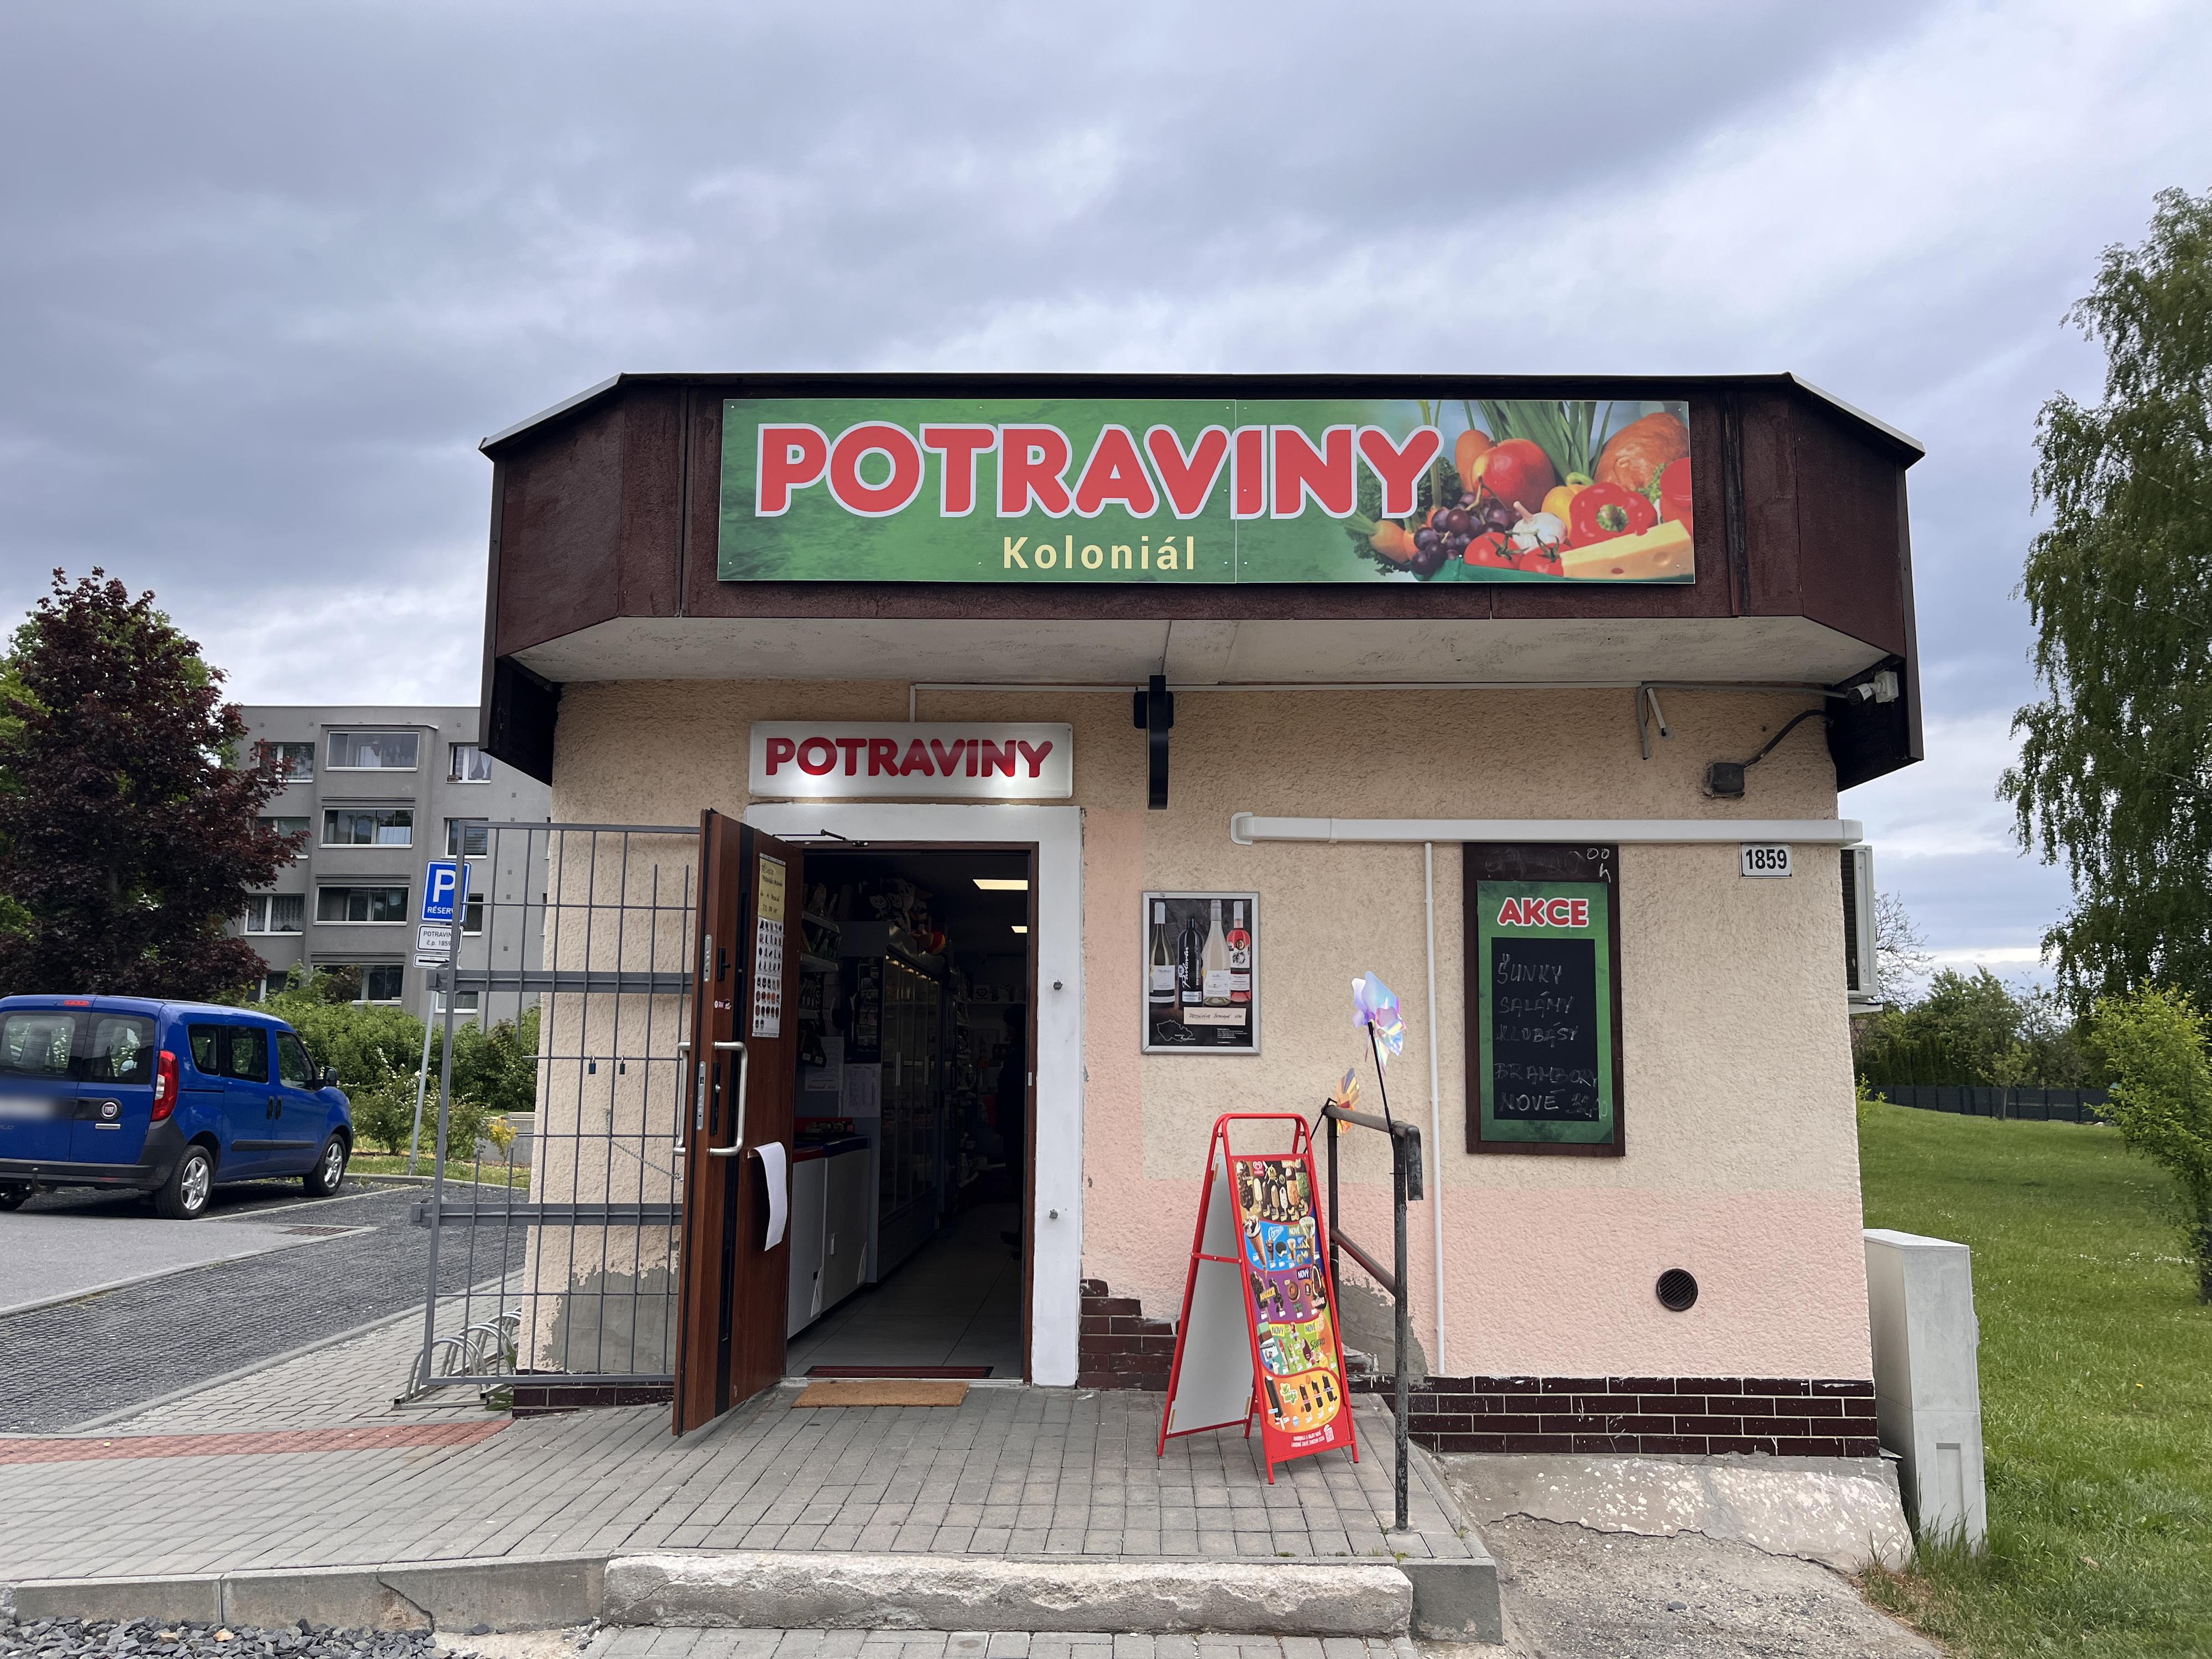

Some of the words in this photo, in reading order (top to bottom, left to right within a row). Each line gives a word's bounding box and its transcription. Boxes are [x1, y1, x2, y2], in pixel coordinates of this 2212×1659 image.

[755, 420, 1444, 519] POTRAVINY
[1003, 535, 1195, 570] Koloniál
[765, 737, 1053, 778] POTRAVINY
[1746, 849, 1787, 870] 1859
[432, 869, 456, 902] P
[1496, 896, 1589, 928] AKCE
[1496, 953, 1563, 985] ŠUNKY
[1499, 990, 1575, 1018] SALÁMY
[1496, 1021, 1579, 1048] KLOBÁSY
[1499, 1088, 1564, 1112] NOVÉ
